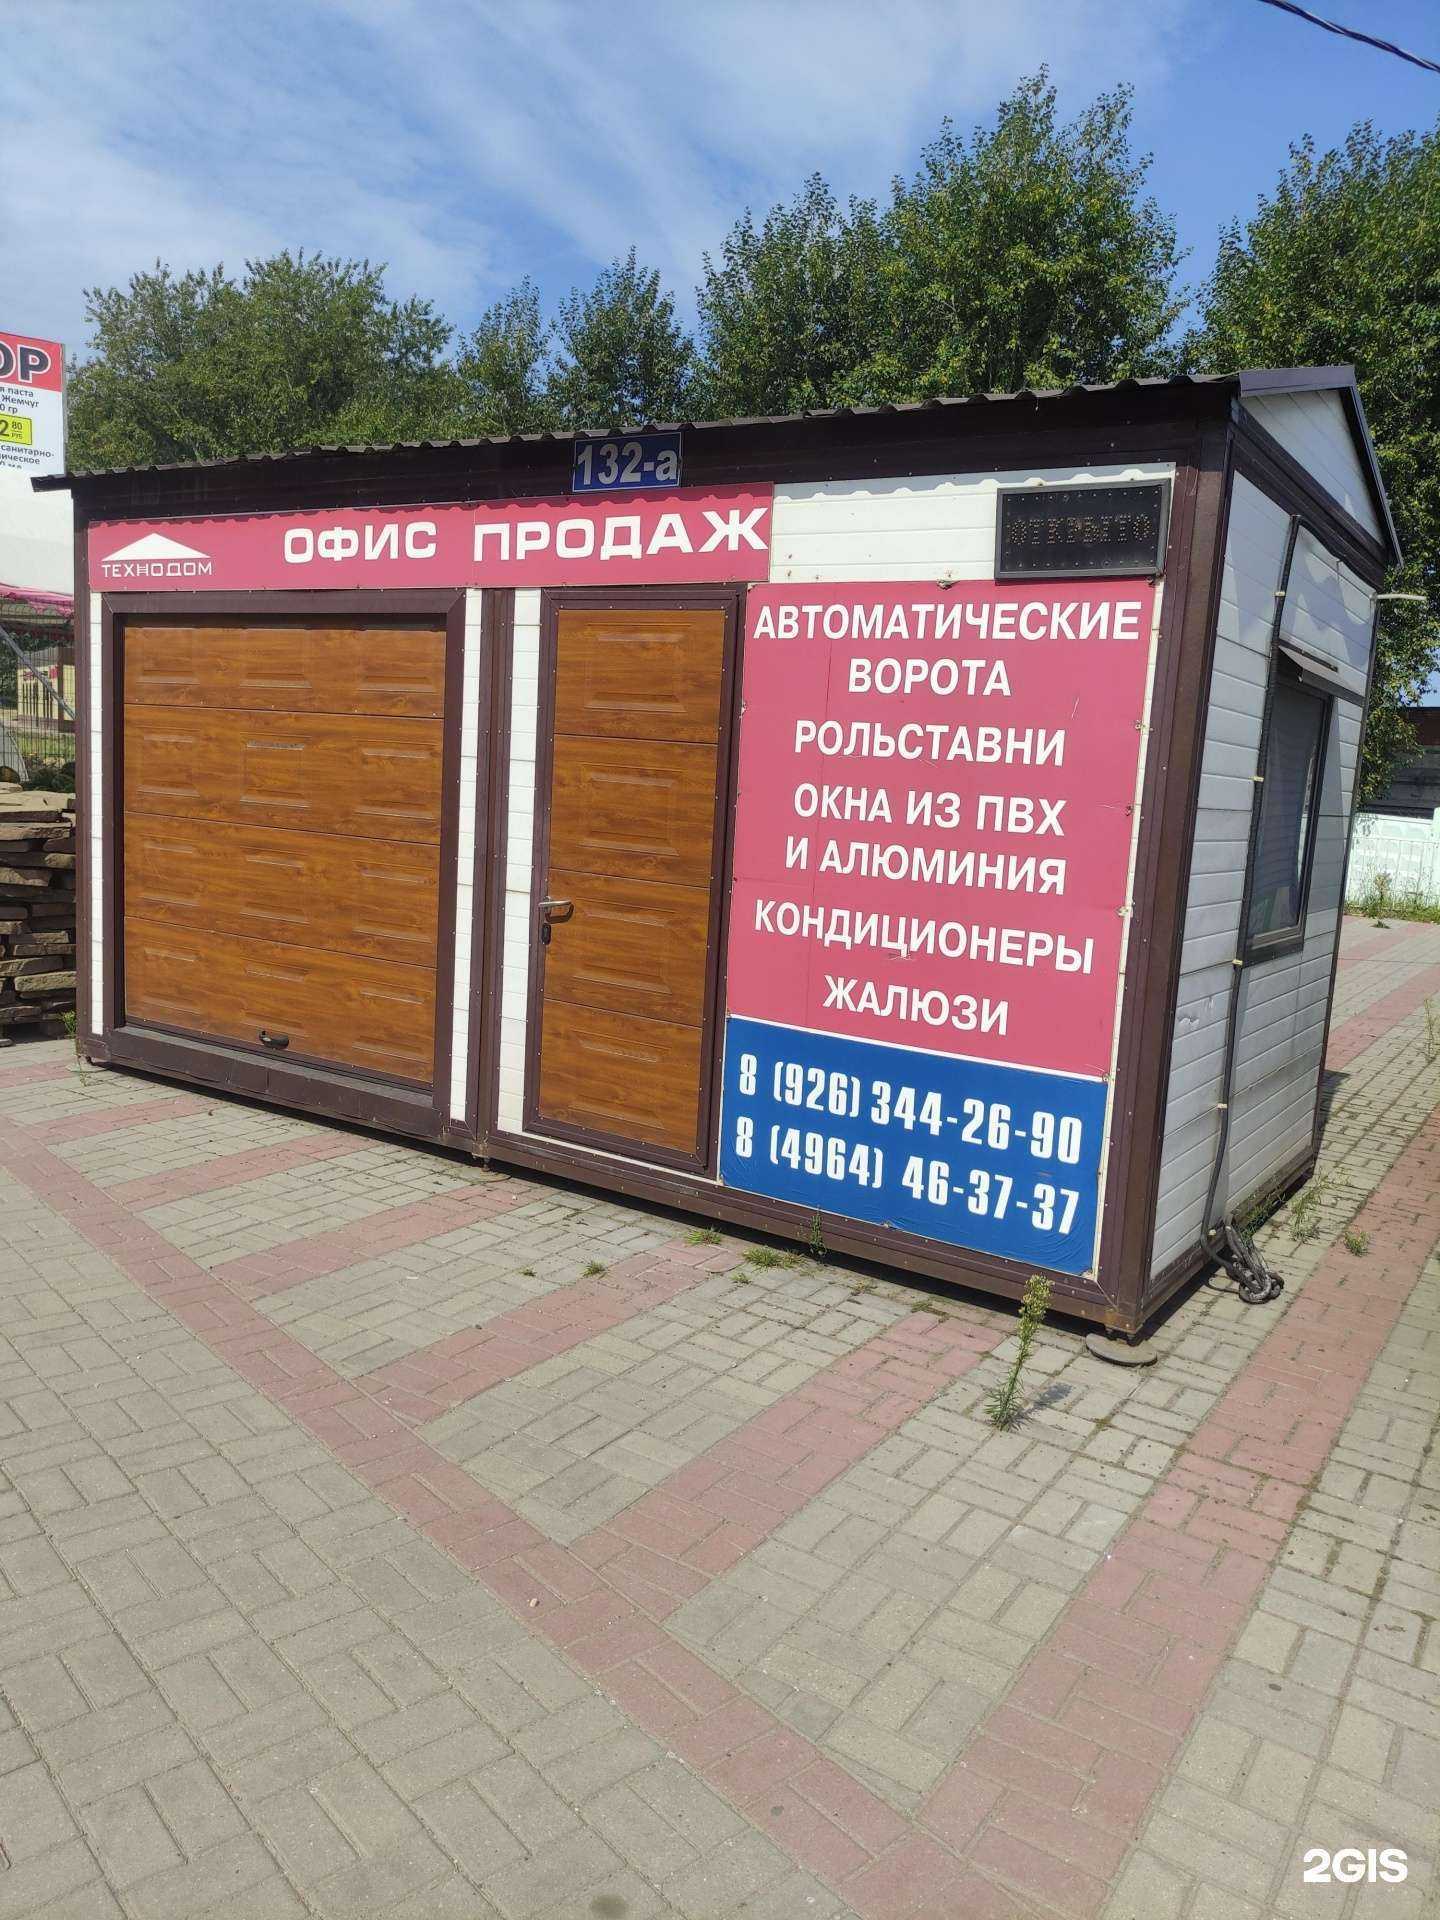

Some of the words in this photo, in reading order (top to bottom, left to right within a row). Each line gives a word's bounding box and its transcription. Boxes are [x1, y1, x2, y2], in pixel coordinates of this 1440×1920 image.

[2, 394, 39, 408] Жемчуг
[7, 388, 34, 398] паста
[8, 406, 18, 414] гр
[0, 453, 40, 465] ическое
[576, 441, 678, 486] 132-а
[284, 521, 437, 563] ОФИС
[474, 508, 769, 561] ПРОДАЖ
[101, 562, 213, 578] ТЕХНОДОМ
[753, 601, 1142, 640] АВТОМАТИЧЕСКИЕ
[848, 657, 1011, 697] ВОРОТА
[794, 720, 1066, 766] РОЛЬСТАВНИ
[793, 783, 893, 824] ОКНА
[905, 790, 961, 829] ИЗ
[976, 795, 1066, 837] ПВХ
[785, 835, 809, 870] И
[819, 839, 1067, 895] АЛЮМИНИЯ
[754, 899, 1095, 974] КОНДИЦИОНЕРЫ
[823, 975, 1009, 1035] ЖАЛЮЗИ
[739, 1053, 758, 1096] 8
[773, 1060, 861, 1118] (926)
[871, 1080, 1083, 1164] 344-26-90
[735, 1116, 754, 1158] 8
[770, 1124, 883, 1189] (4964)
[901, 1156, 1080, 1235] 46-37-37
